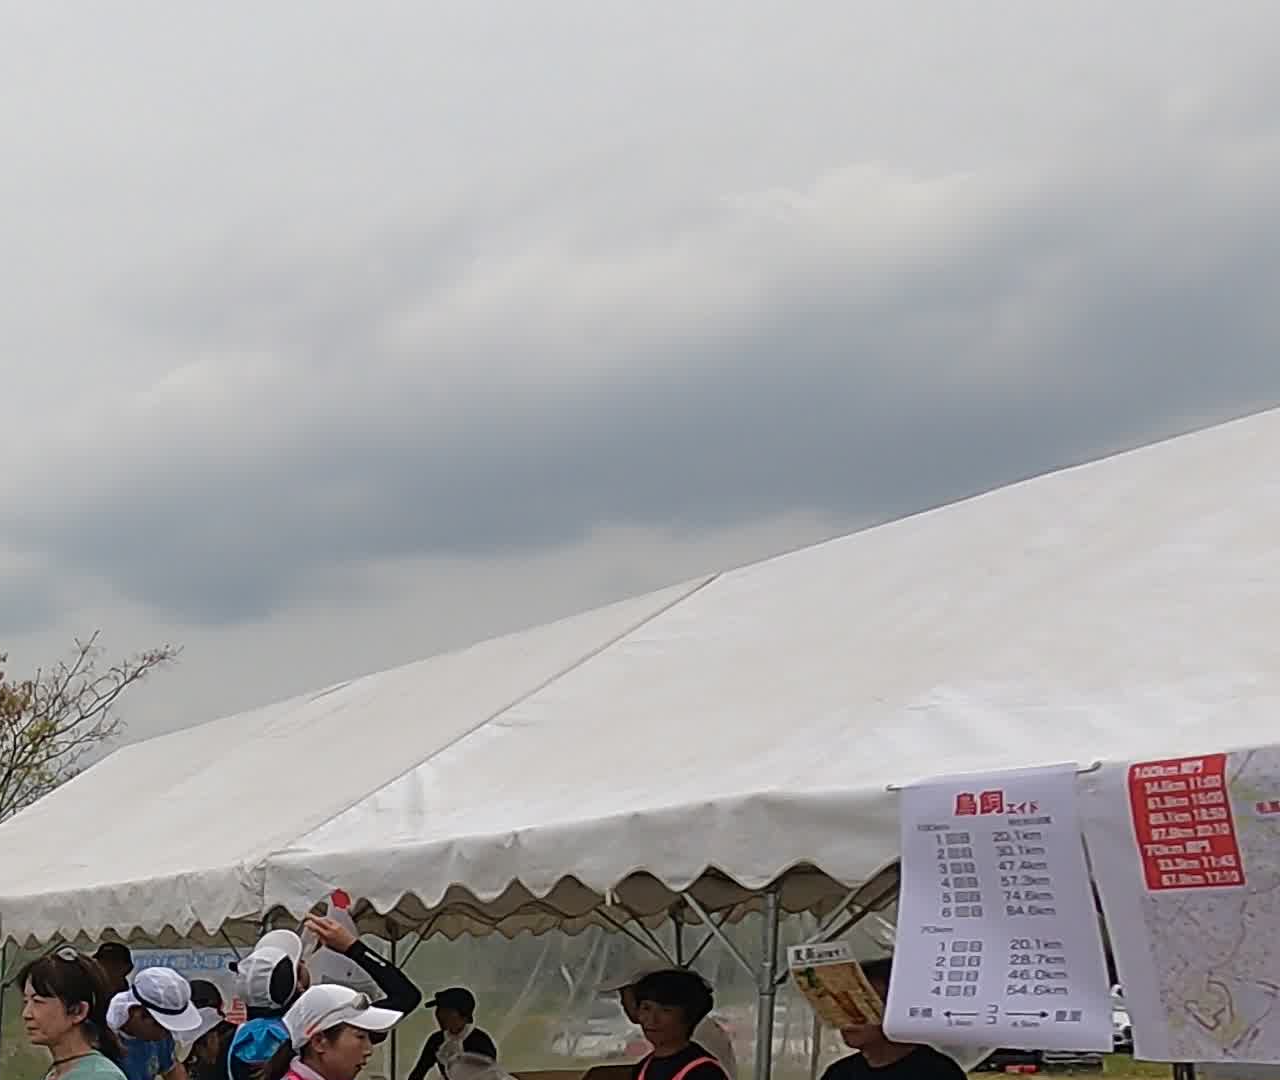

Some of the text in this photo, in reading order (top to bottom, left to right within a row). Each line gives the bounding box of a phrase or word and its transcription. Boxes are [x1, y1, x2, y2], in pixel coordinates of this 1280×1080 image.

[993, 831, 1042, 843] 20.1km
[1009, 938, 1063, 950] 20.1km
[1009, 954, 1067, 966] 28.7km
[1007, 969, 1068, 980] 46.0km
[1006, 984, 1069, 996] 54.6km
